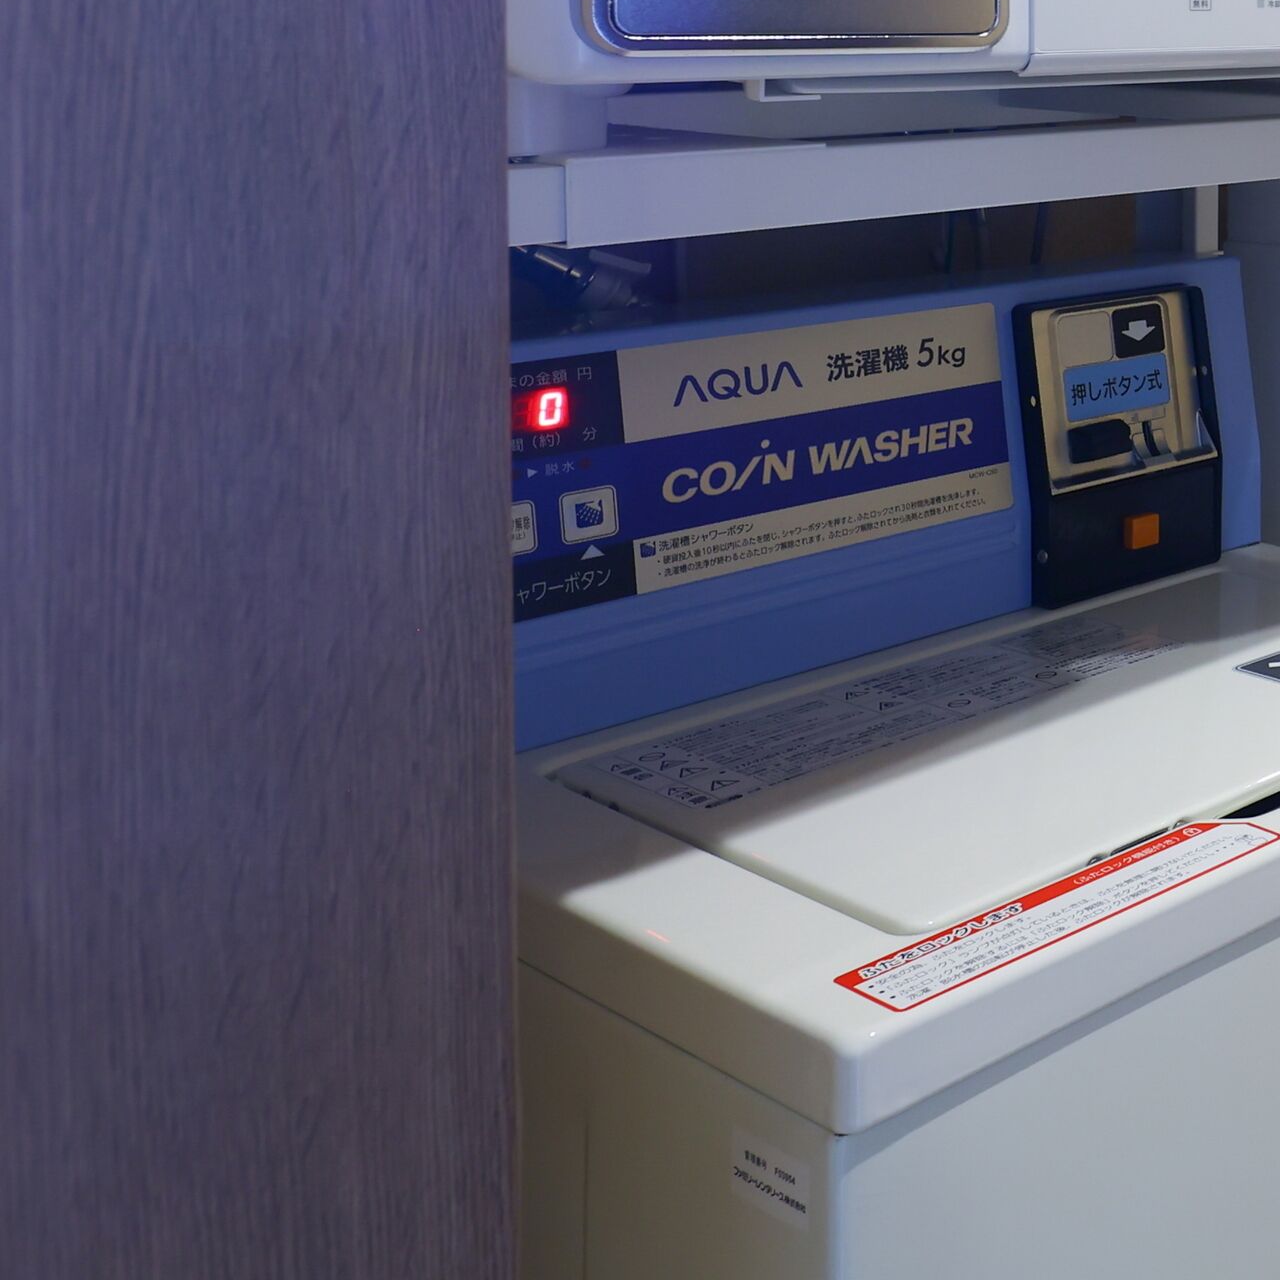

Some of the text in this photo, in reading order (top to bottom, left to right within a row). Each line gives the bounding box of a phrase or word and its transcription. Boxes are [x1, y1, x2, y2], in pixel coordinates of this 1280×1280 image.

[673, 337, 966, 407] AQUA 洗濯機 5kg
[1072, 369, 1162, 407] 押しボタン式
[538, 391, 563, 427] 0
[809, 417, 974, 475] WASHER
[858, 901, 1023, 981] ふたをロックします
